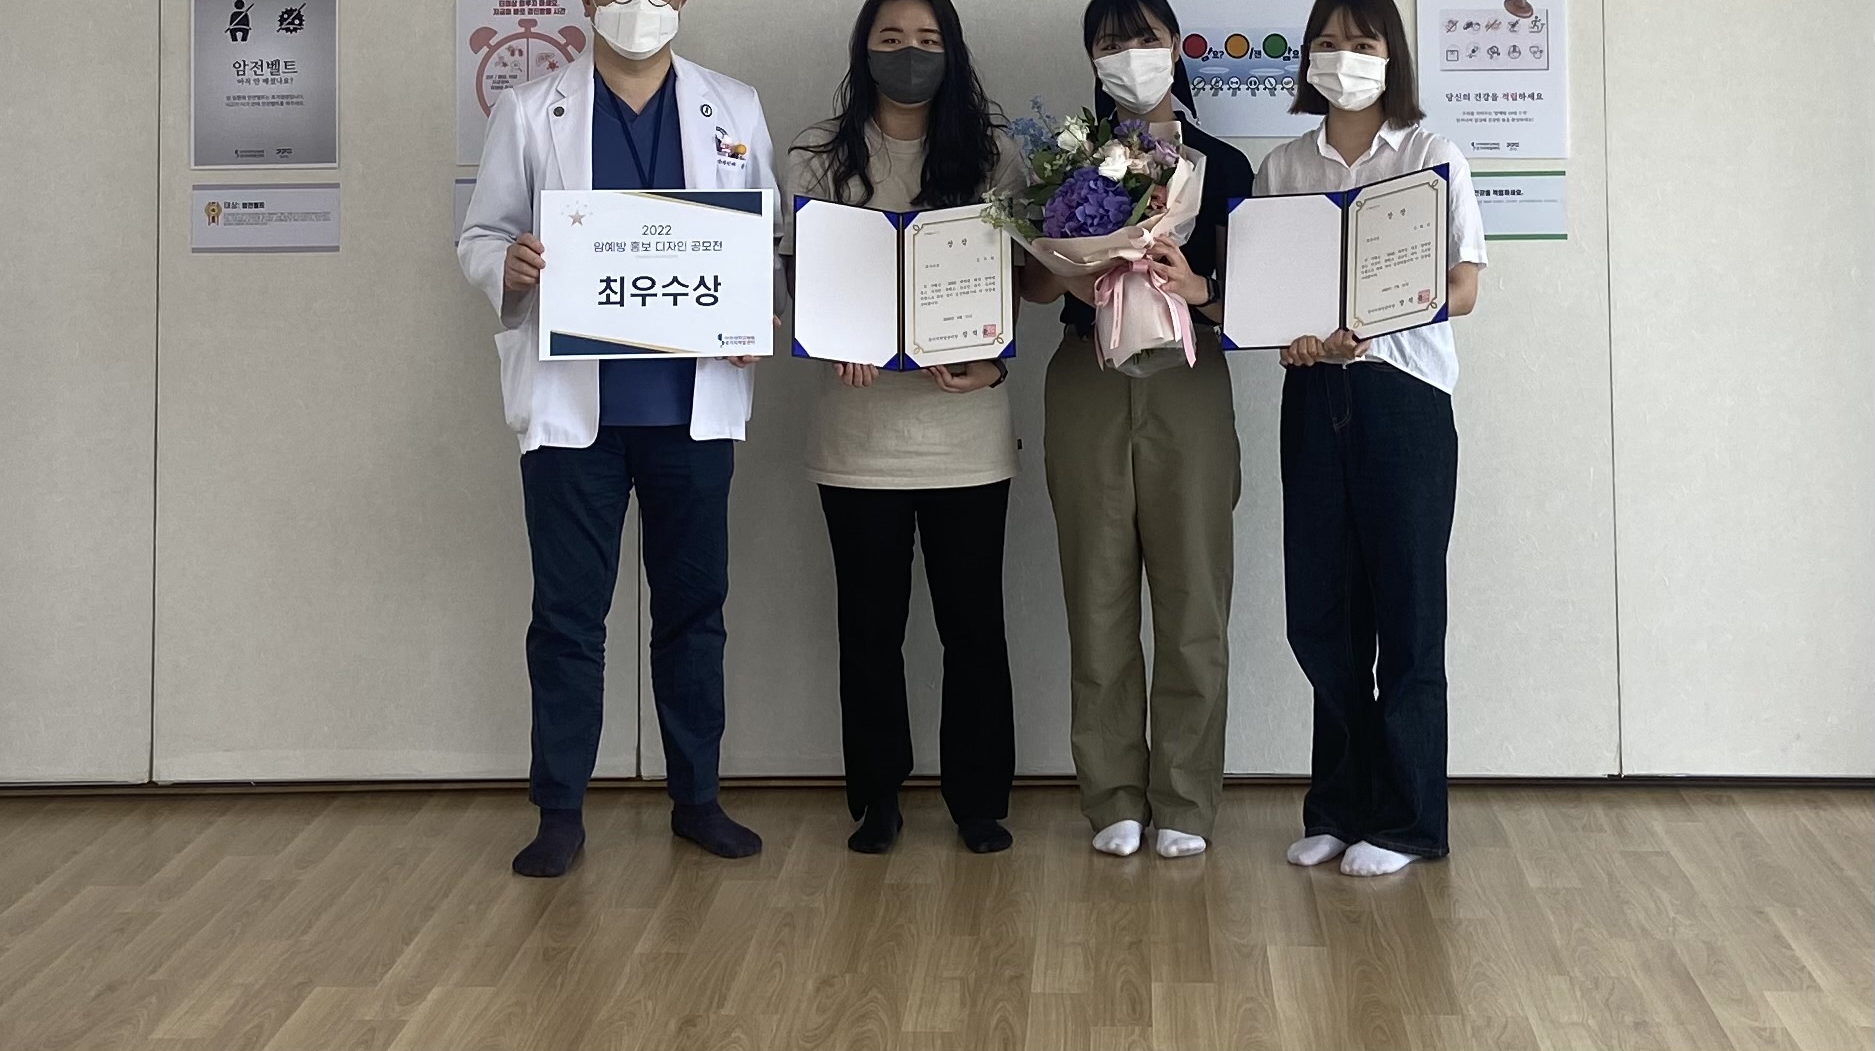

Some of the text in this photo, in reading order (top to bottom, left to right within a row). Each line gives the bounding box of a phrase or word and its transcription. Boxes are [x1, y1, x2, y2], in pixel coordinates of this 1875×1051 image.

[232, 58, 299, 77] 암전벨트
[1445, 91, 1544, 102] 당신의 건강을 적립하세요
[641, 224, 673, 237] 2022
[593, 239, 723, 253] 암예방 홍보 디자인 공모전
[597, 274, 722, 308] 최우수상
